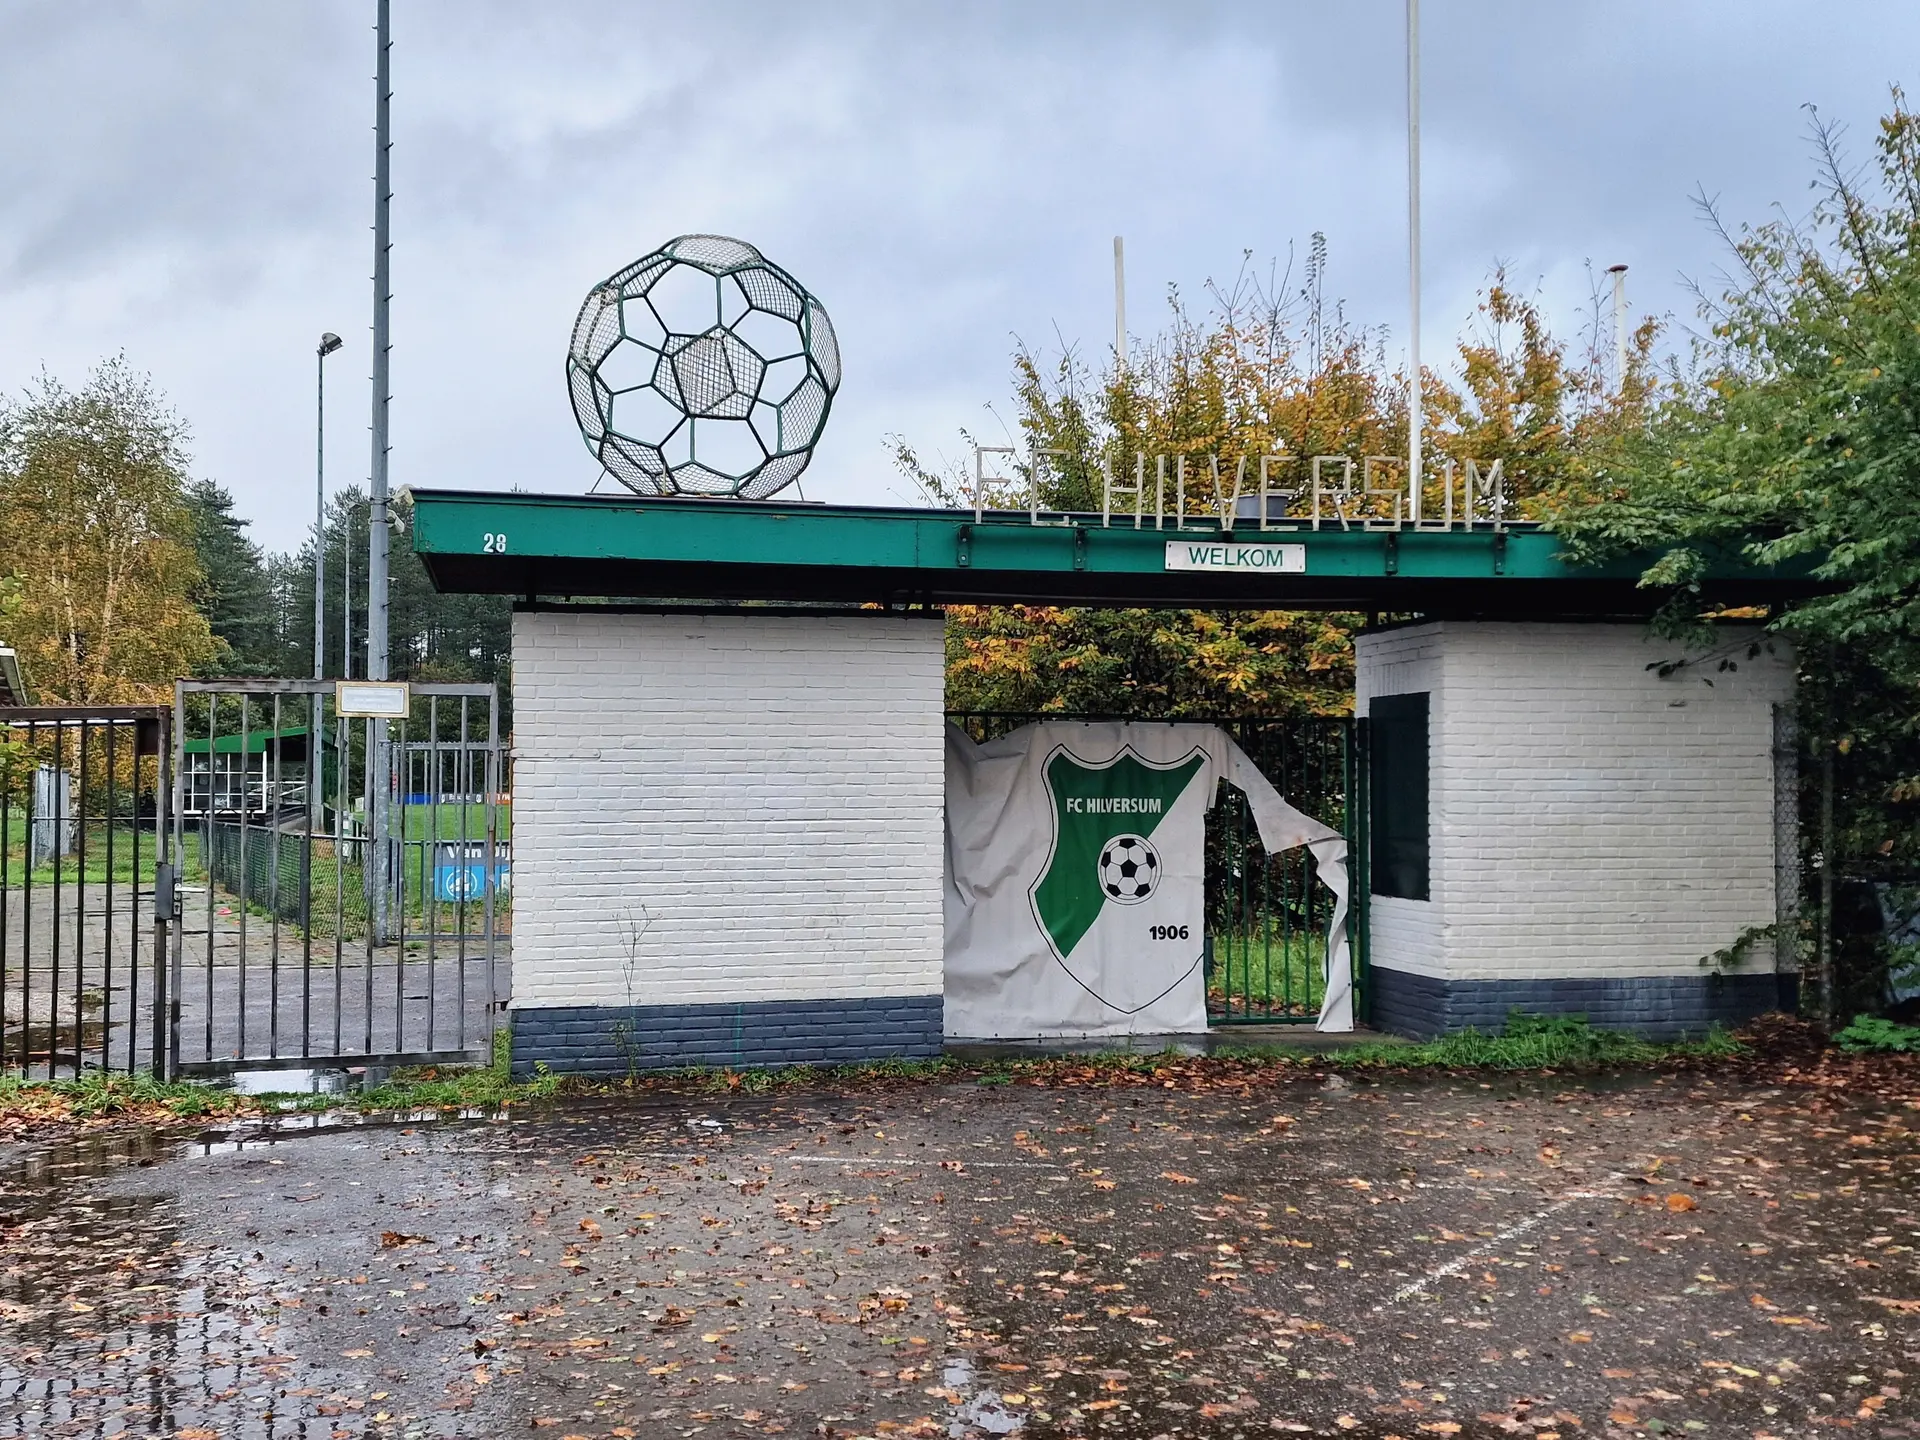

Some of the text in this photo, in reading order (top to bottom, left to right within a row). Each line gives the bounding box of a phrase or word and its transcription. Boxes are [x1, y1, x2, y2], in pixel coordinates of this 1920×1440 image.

[975, 446, 1504, 533] FC HILVERSUM
[483, 532, 507, 553] 28
[1188, 546, 1284, 567] WELKOM
[1066, 798, 1162, 814] FC HILVERSUM
[446, 845, 482, 859] Van
[1149, 925, 1189, 940] 1906
